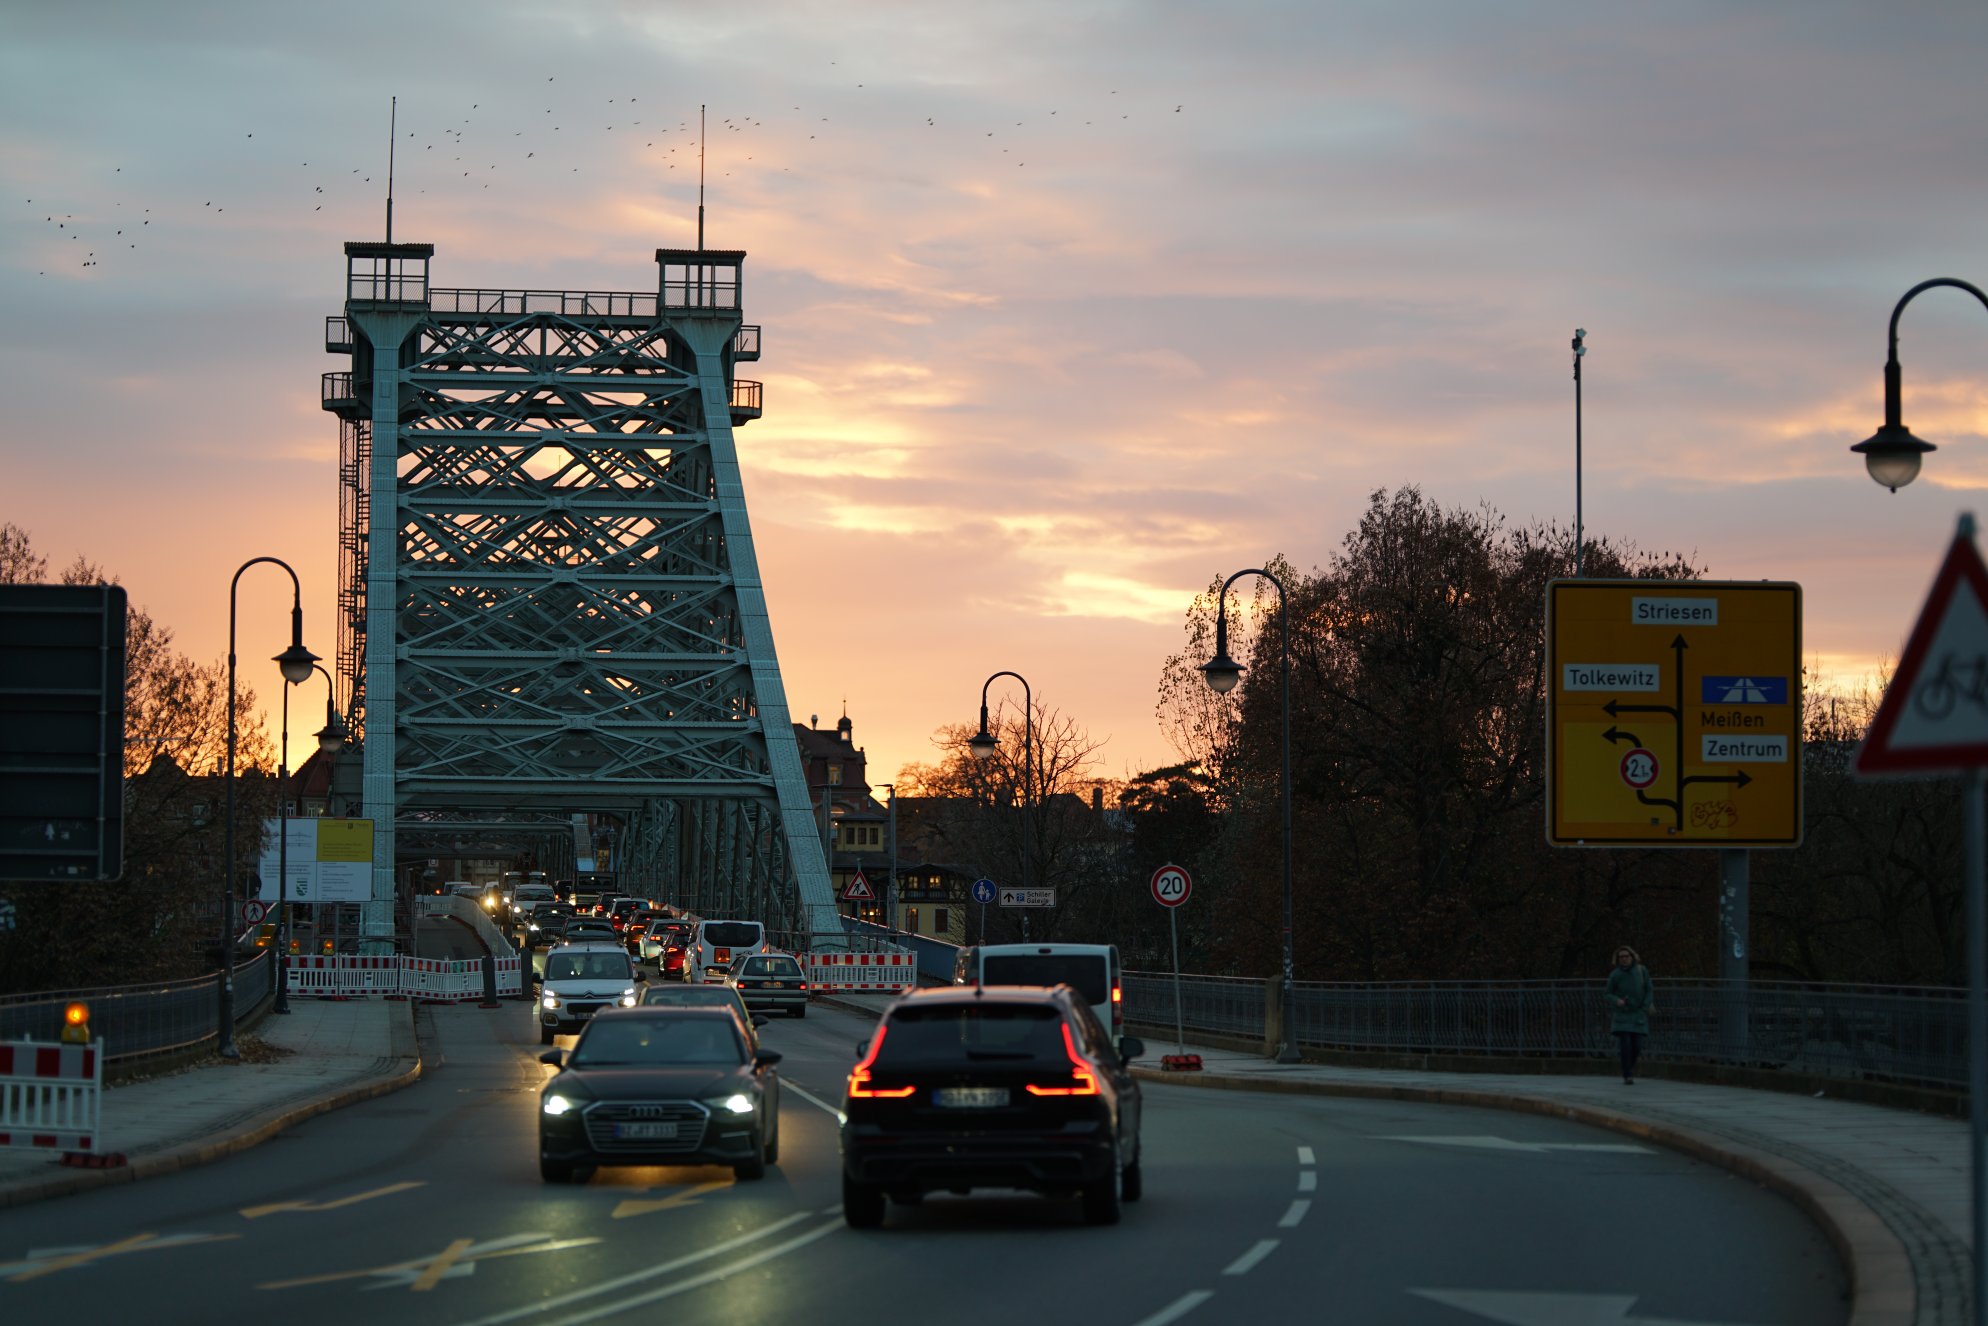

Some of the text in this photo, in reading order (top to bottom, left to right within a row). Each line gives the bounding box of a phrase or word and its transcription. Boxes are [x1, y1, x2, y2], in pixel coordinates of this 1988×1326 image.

[1638, 602, 1712, 620] Striesen
[1569, 669, 1654, 687] Tolkewitz
[1701, 711, 1764, 728] Meißen
[1708, 740, 1782, 757] Zentrum
[1161, 876, 1182, 895] 20
